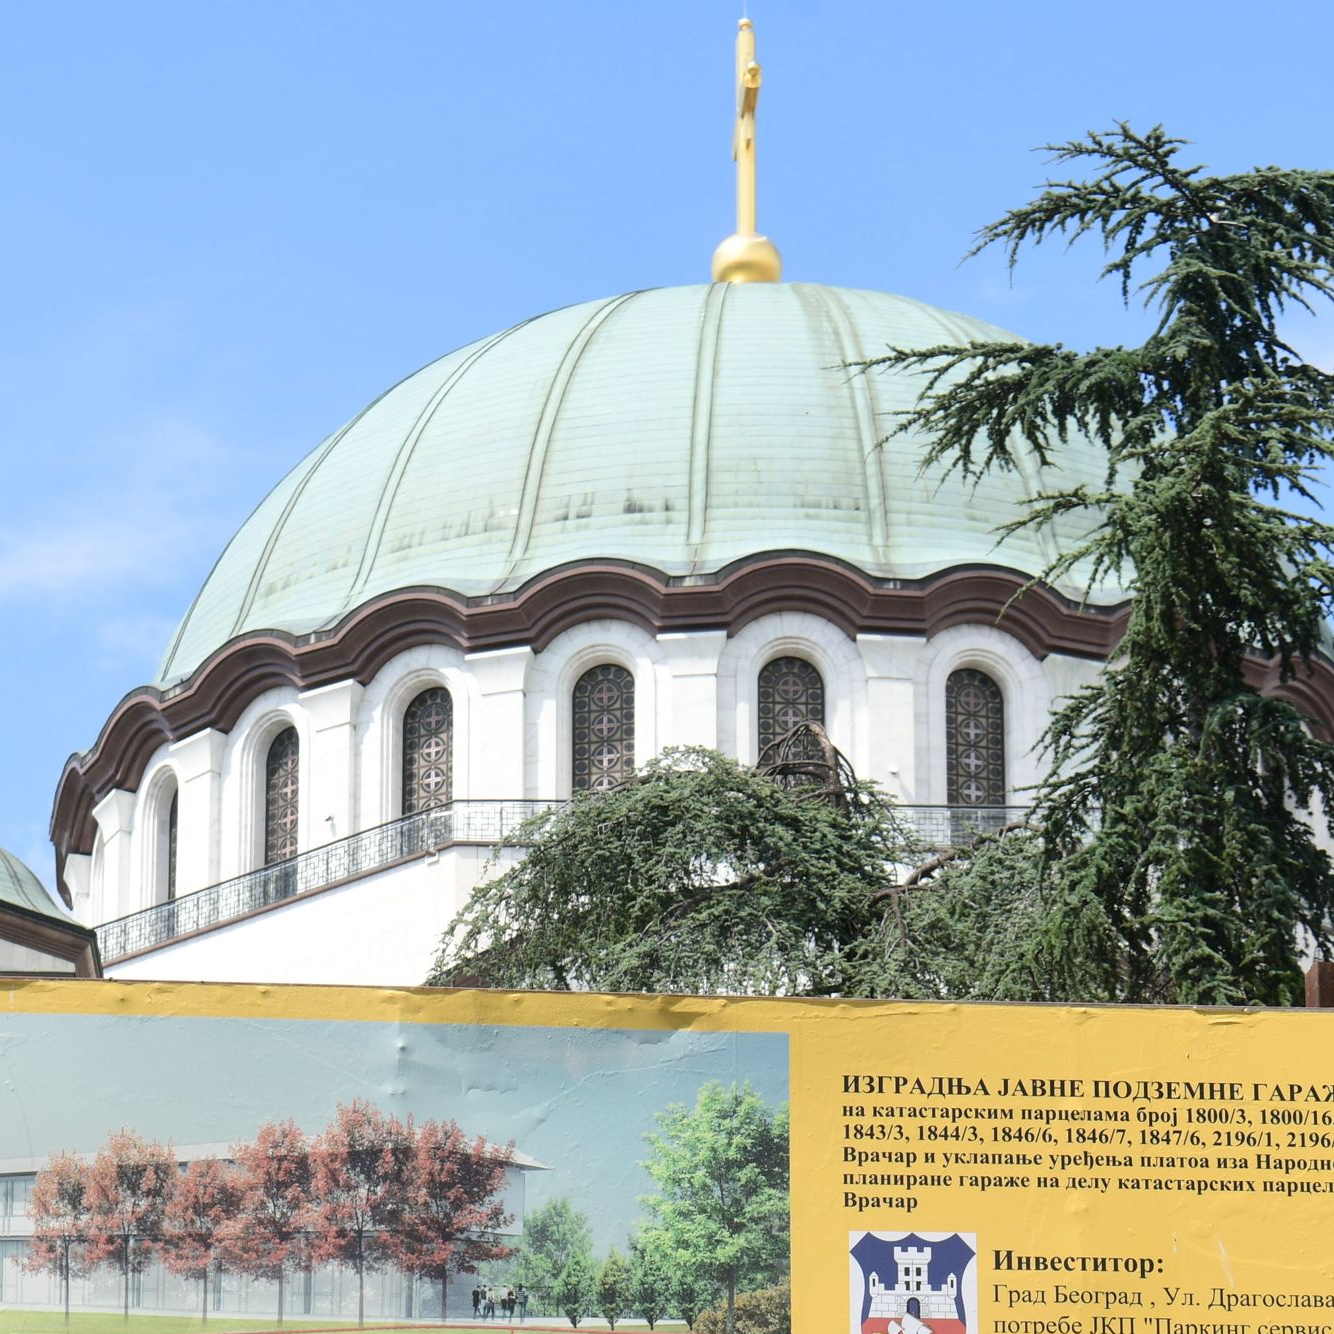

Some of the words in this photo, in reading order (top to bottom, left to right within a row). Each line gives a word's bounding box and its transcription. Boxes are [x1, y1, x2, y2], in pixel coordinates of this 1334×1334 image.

[841, 1075, 992, 1100] ИЗГРАДЊА
[997, 1078, 1085, 1098] ЈАВНЕ
[1091, 1080, 1245, 1104] ПОДЗЕМНЕ
[842, 1106, 866, 1118] на
[871, 1106, 1015, 1124] катастарским
[1019, 1109, 1131, 1126] парцелама
[1136, 1107, 1178, 1128] број
[1185, 1108, 1253, 1129] 1800/3,
[842, 1124, 911, 1145] 1843/3,
[916, 1125, 985, 1146] 1844/3,
[991, 1126, 1059, 1147] 1846/6,
[1065, 1128, 1133, 1149] 1846/7,
[1138, 1129, 1207, 1150] 1847/6,
[1211, 1131, 1281, 1152] 2196/1,
[842, 1147, 918, 1169] Врачар
[923, 1152, 936, 1164] и
[941, 1153, 1043, 1169] уклапање
[1047, 1151, 1135, 1171] уређења
[1139, 1156, 1211, 1169] платоа
[1215, 1158, 1250, 1170] иза
[842, 1174, 953, 1191] планиране
[958, 1176, 1031, 1192] гараже
[1036, 1177, 1061, 1189] на
[1065, 1177, 1112, 1194] делу
[1117, 1178, 1256, 1196] катастарских
[842, 1192, 919, 1214] Врачар
[991, 1250, 1164, 1280] Инвеститор:
[992, 1284, 1047, 1309] Град
[1053, 1285, 1144, 1310] Београд
[1162, 1287, 1201, 1307] Ул.
